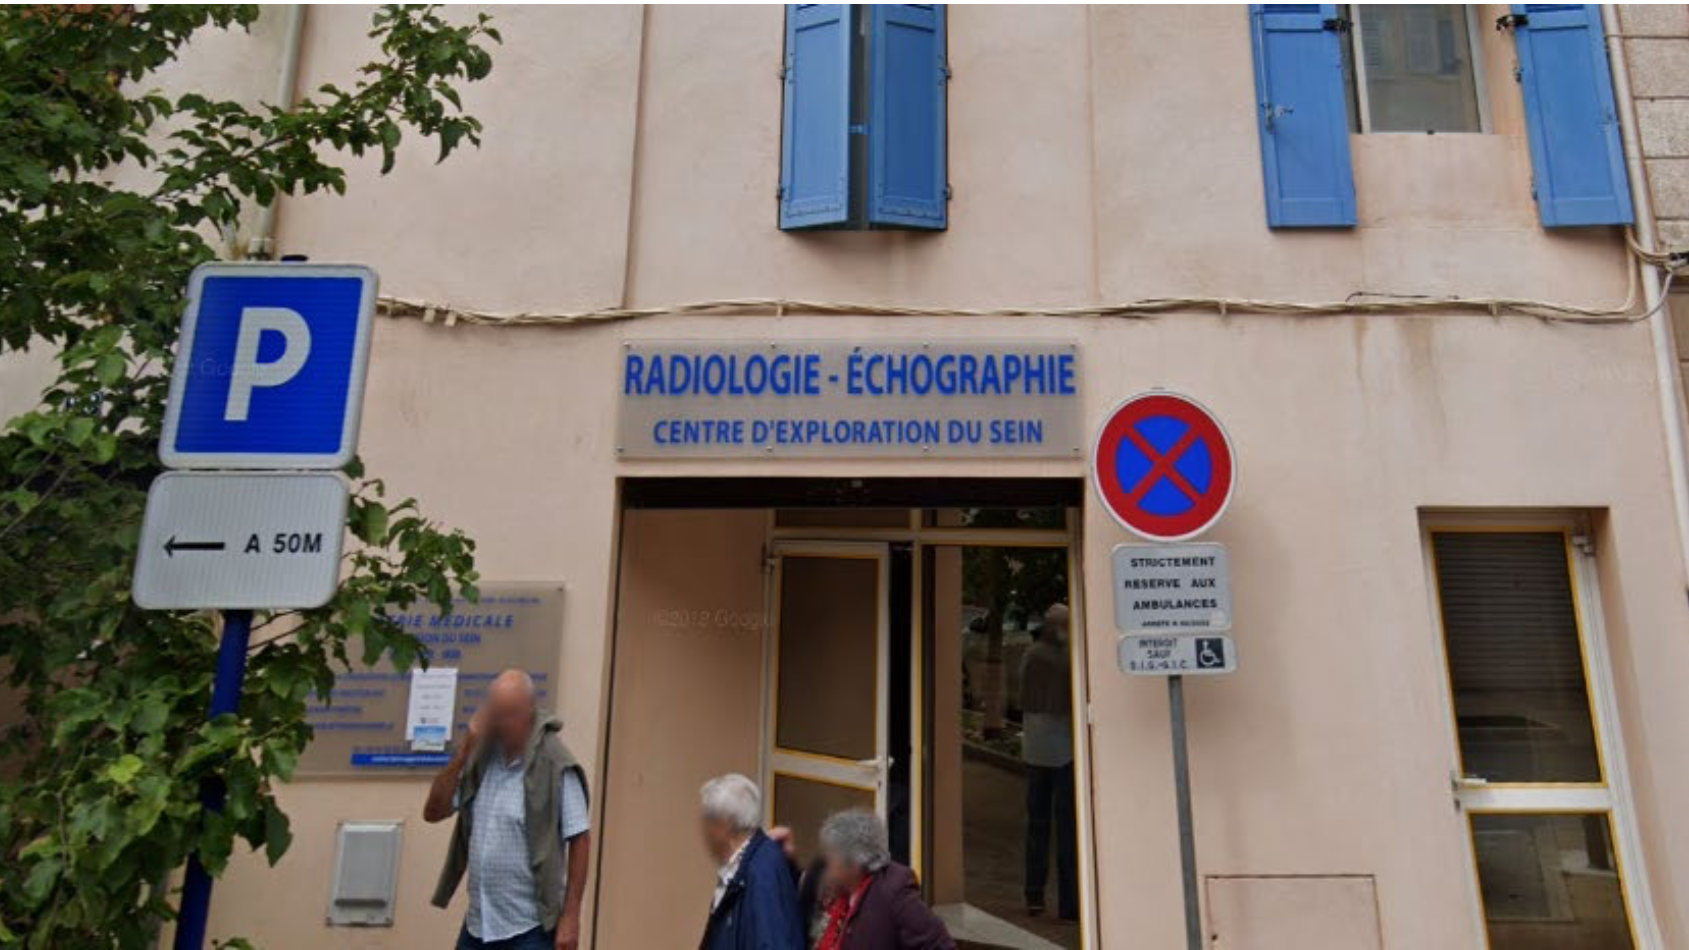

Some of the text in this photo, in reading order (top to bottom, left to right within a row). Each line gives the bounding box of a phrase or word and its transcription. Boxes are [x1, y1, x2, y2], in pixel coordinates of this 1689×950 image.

[224, 307, 312, 421] P
[625, 346, 1076, 396] RADIOLOGIE - ÉCHOGRAPHIE
[653, 420, 1043, 444] CENTRE D'EXPLORATION DU SEIN
[245, 532, 322, 553] A 50M
[1131, 556, 1215, 567] STRICTEMENT
[1125, 578, 1215, 589] RESERVE AUX
[1133, 599, 1217, 610] AMBULANCES
